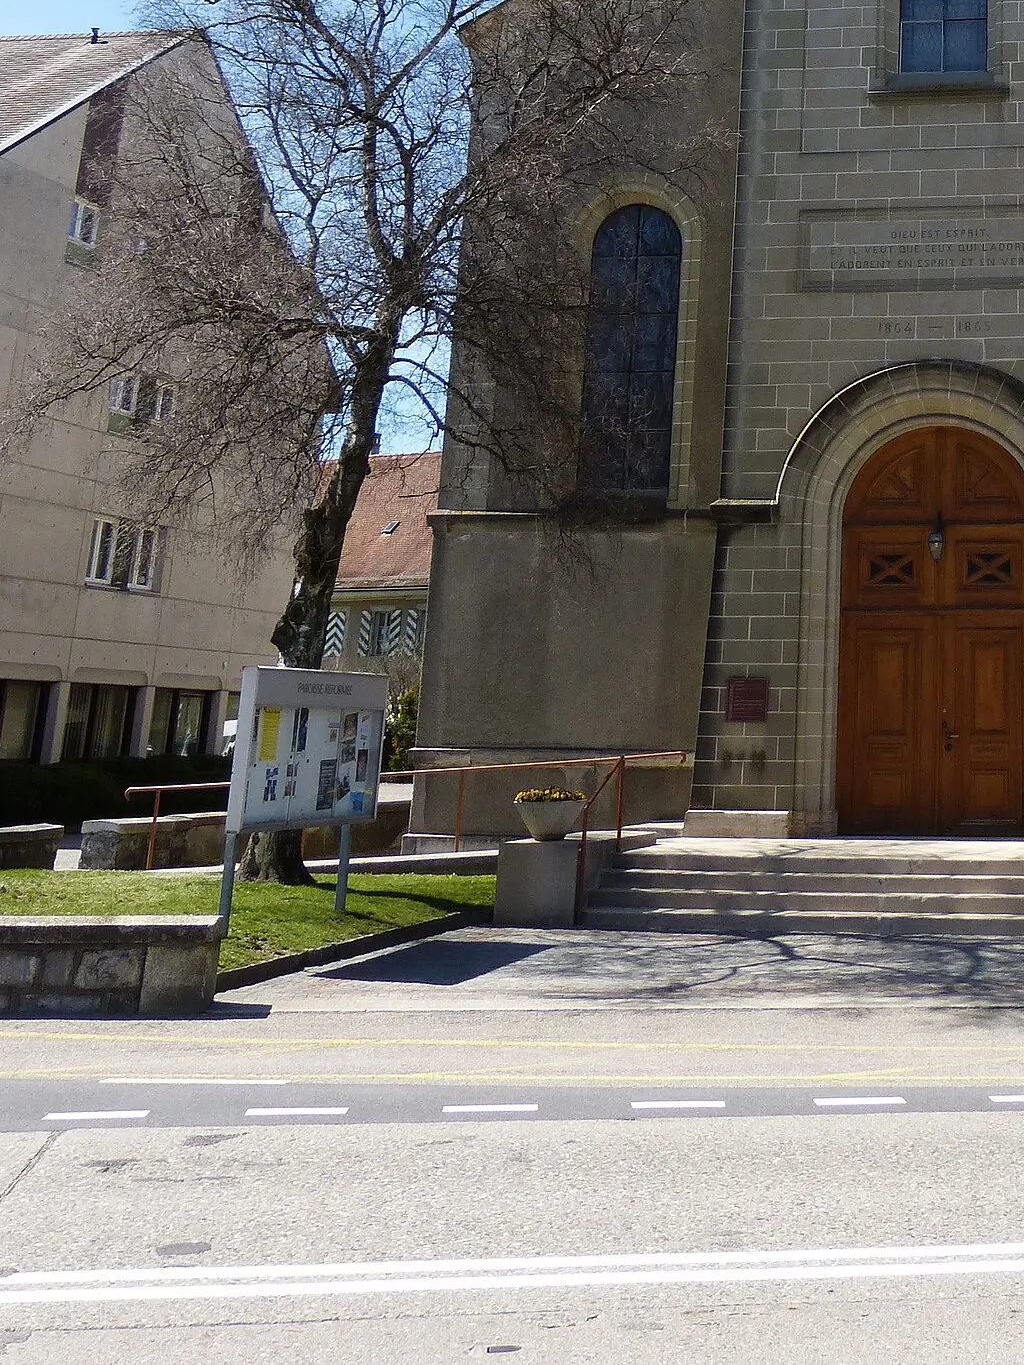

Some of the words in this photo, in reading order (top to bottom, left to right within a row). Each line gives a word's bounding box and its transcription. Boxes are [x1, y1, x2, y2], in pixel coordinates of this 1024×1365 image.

[891, 230, 916, 240] DIEU
[921, 229, 940, 239] EST
[865, 245, 894, 254] VEUT
[898, 244, 919, 254] QUE
[924, 243, 952, 253] CEUX
[958, 243, 977, 252] QUI
[830, 260, 893, 270] L'ADORENT
[897, 259, 913, 268] EN
[917, 258, 955, 269] ESPRIT
[961, 258, 974, 267] ET
[980, 258, 995, 267] EN
[878, 322, 912, 334] 1864
[958, 321, 991, 332] 1865
